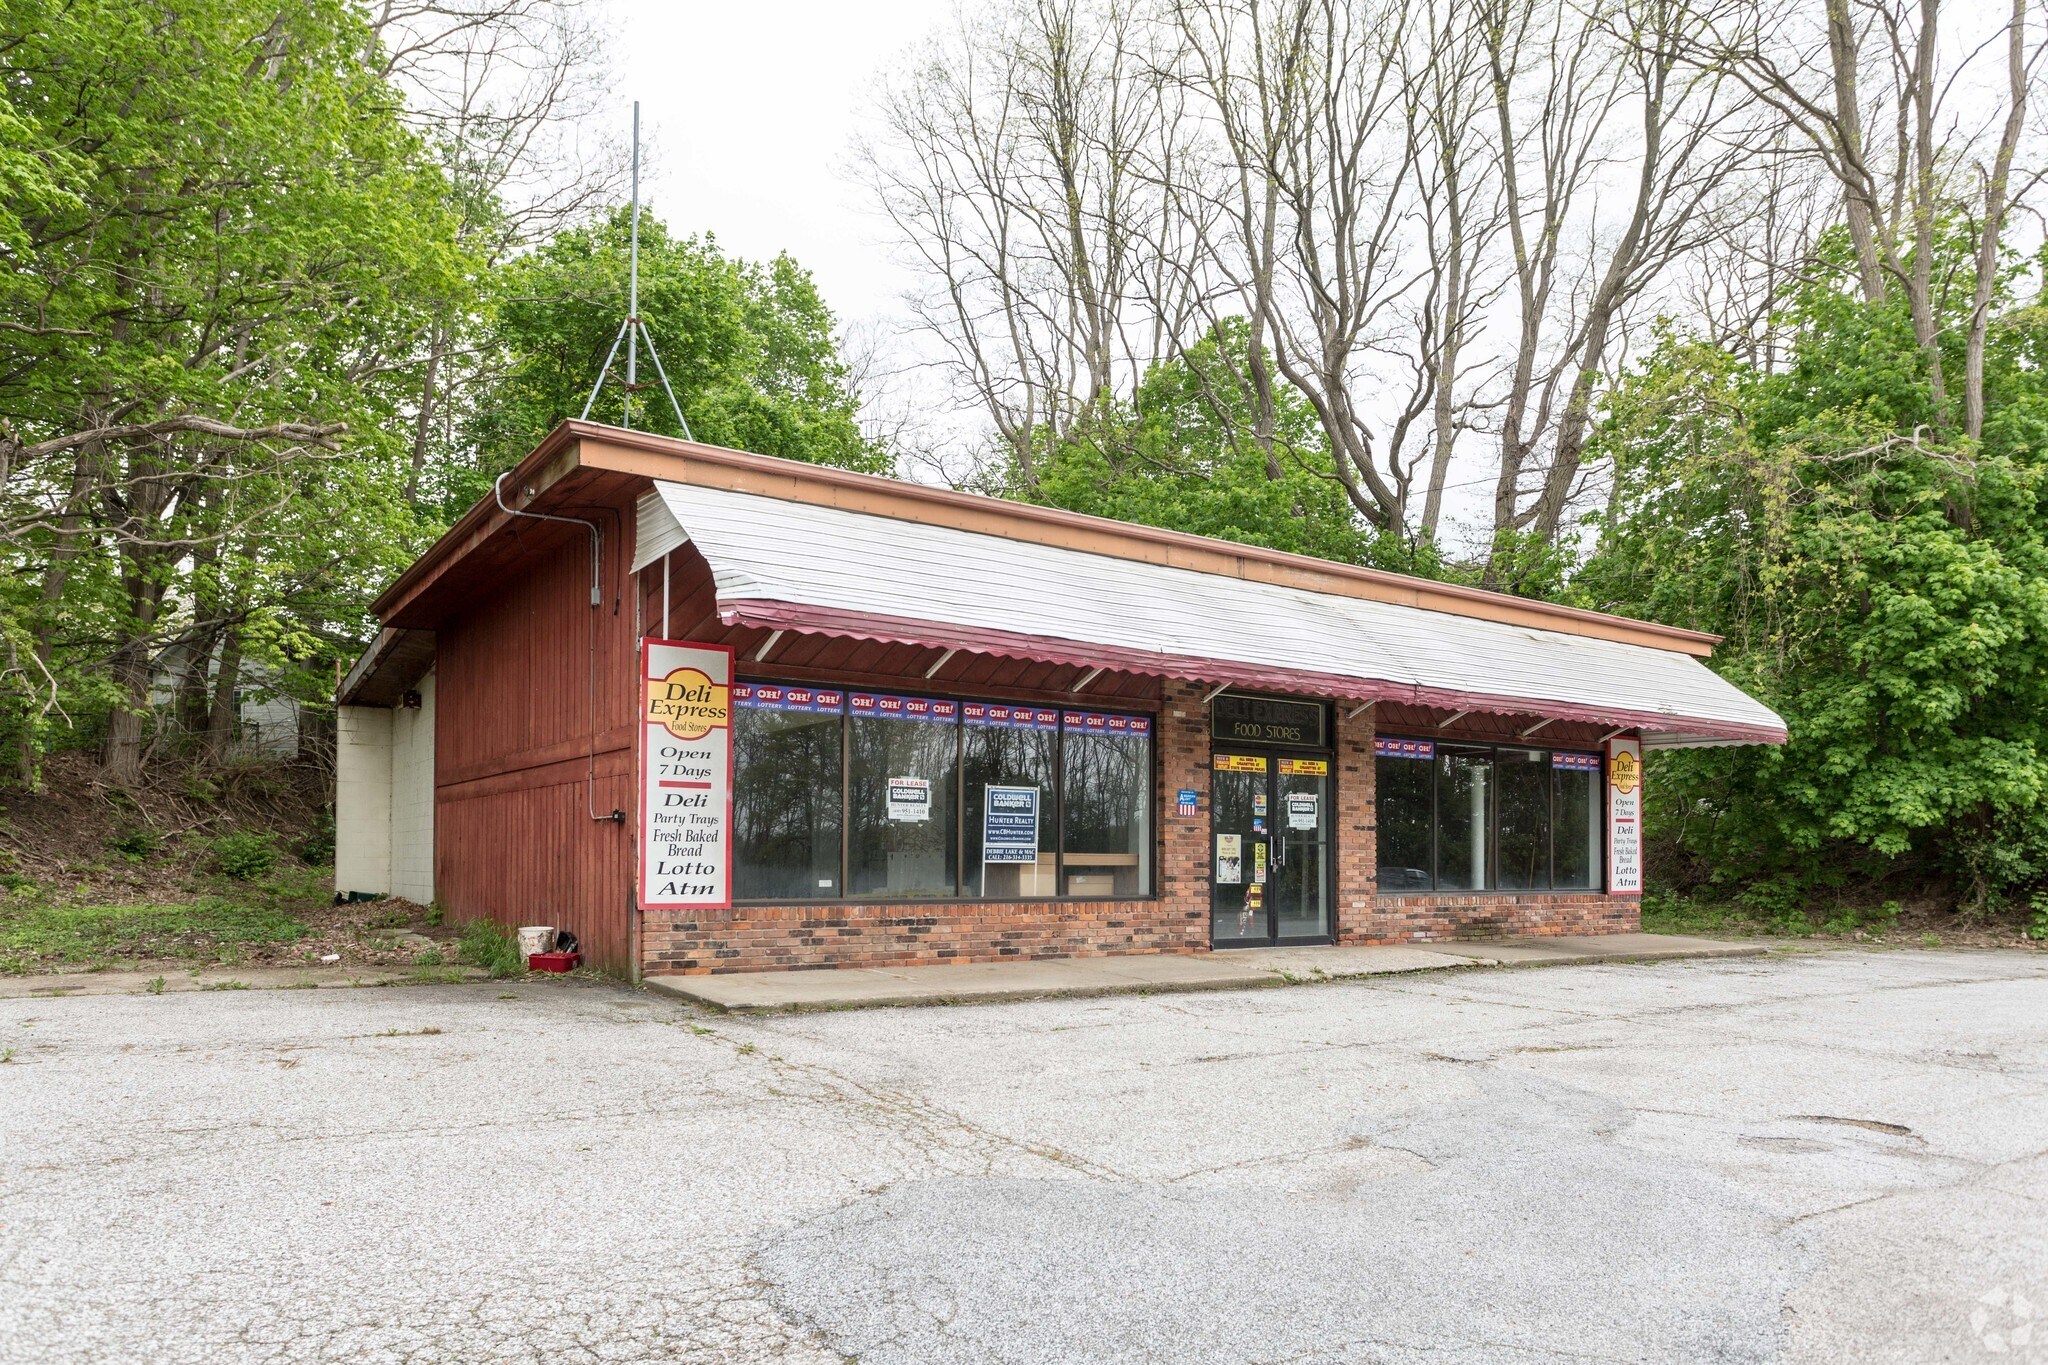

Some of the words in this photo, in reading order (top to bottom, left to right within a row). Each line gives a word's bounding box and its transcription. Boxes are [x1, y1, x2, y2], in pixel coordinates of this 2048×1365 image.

[665, 683, 712, 703] Deli
[733, 688, 751, 697] H!
[757, 690, 781, 699] OH!
[787, 692, 811, 702] OH!
[816, 695, 840, 704] OH!
[650, 699, 727, 720] Express
[851, 698, 874, 707] OH!
[879, 700, 901, 709] OH!
[906, 702, 928, 711] OH!
[933, 704, 954, 713] OH!
[1215, 698, 1249, 719] DELI
[964, 707, 984, 716] OH!
[989, 709, 1009, 718] OH!
[1013, 711, 1033, 720] OH!
[1037, 713, 1056, 722] OH!
[672, 721, 687, 731] Food
[689, 722, 707, 732] Stores
[1064, 716, 1083, 724] OH!
[1086, 717, 1105, 726] OH!
[1108, 719, 1126, 727] OH!
[1130, 721, 1148, 729] OH!
[1234, 722, 1261, 737] FOOD
[1266, 725, 1300, 740] STORES
[660, 747, 711, 761] Open
[660, 764, 668, 775] 7
[673, 765, 712, 780] Days
[1616, 761, 1633, 772] Deli
[1611, 771, 1639, 783] Express
[663, 793, 708, 807] Deli
[1615, 798, 1634, 807] Open
[653, 813, 686, 827] Party
[689, 813, 719, 827] Trays
[988, 816, 1013, 824] HUNTER
[1014, 816, 1034, 824] REALTY
[1620, 809, 1635, 817] Days
[653, 829, 682, 842] Fresh
[685, 829, 719, 843] Baked
[1617, 826, 1634, 835] Deli
[1613, 838, 1626, 846] Party
[667, 843, 703, 857] Bread
[1613, 847, 1625, 855] Fresh
[1625, 847, 1637, 855] Baked
[656, 861, 715, 875] Lotto
[1615, 866, 1637, 875] Lotto
[656, 881, 715, 895] Atm
[1616, 878, 1637, 887] Atm
